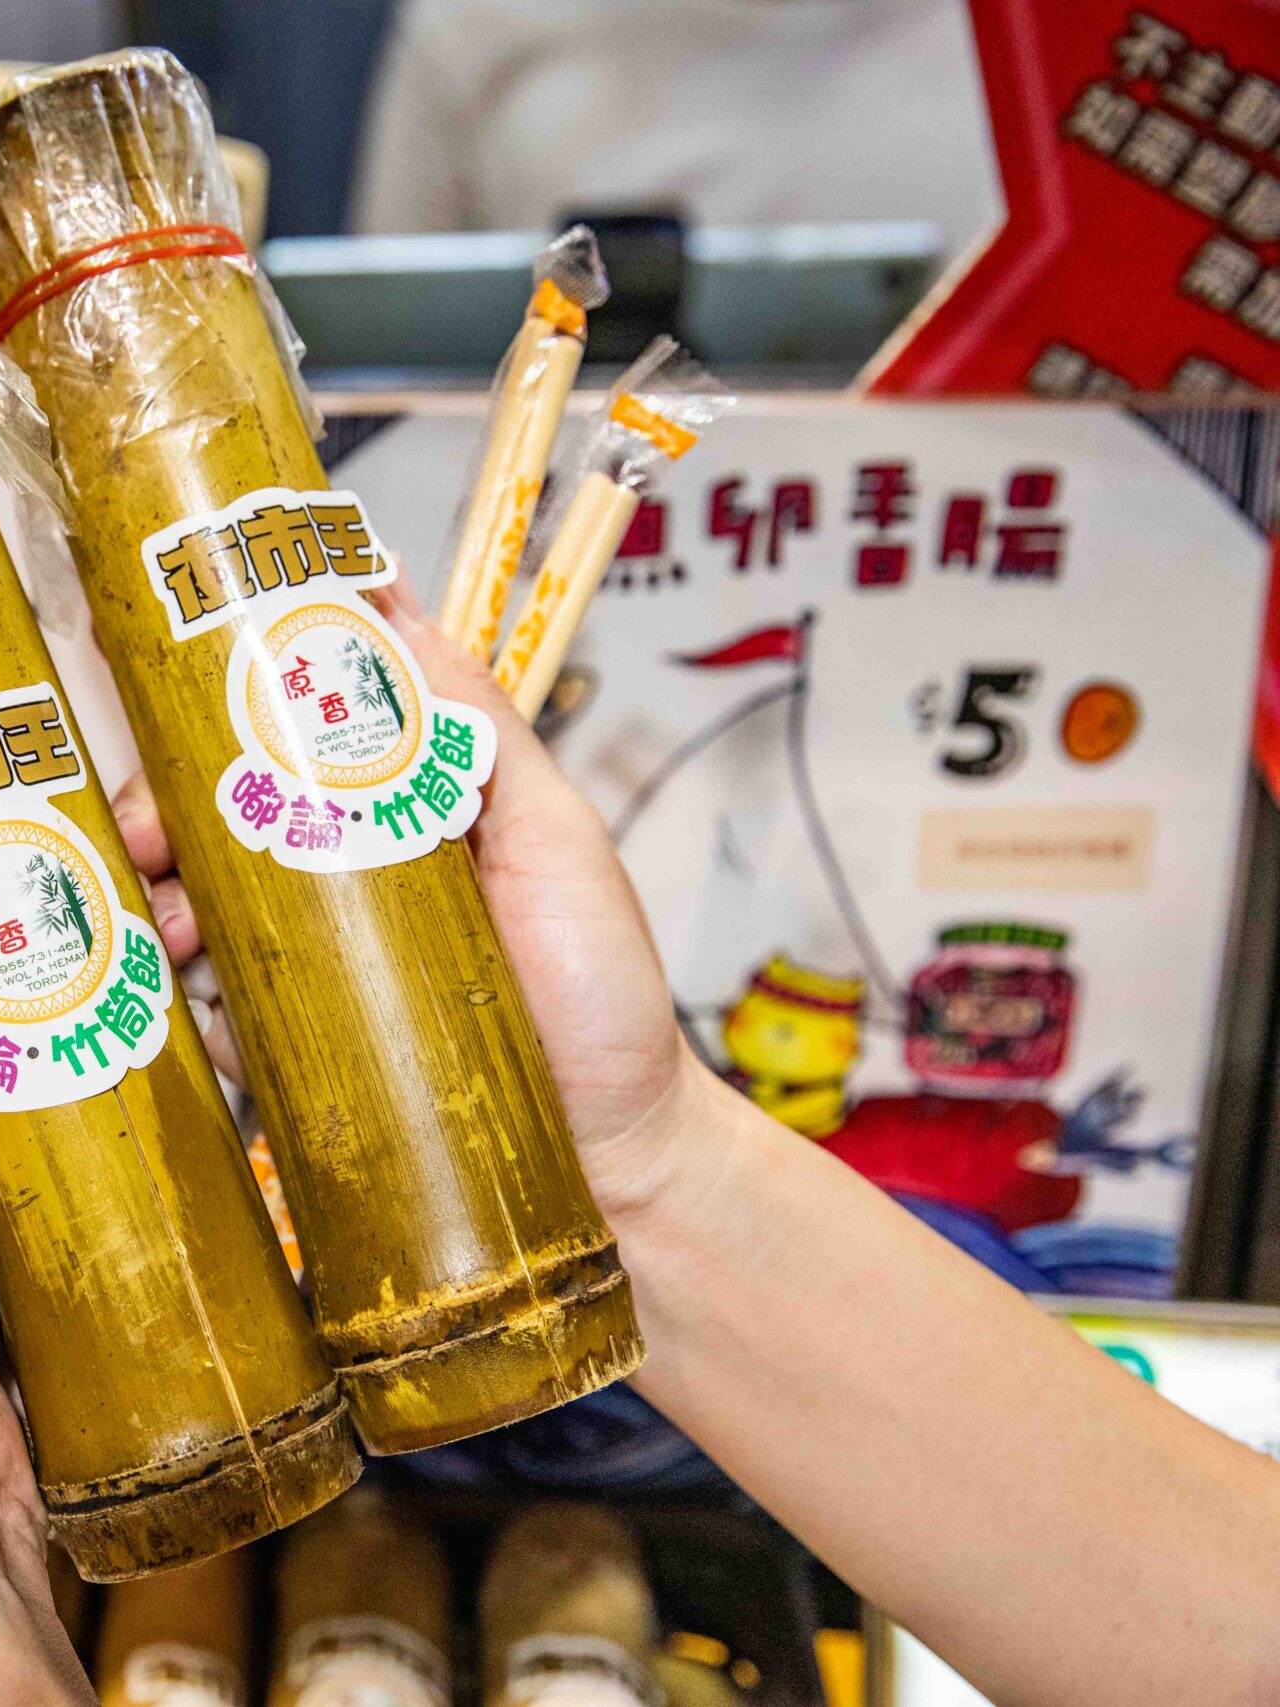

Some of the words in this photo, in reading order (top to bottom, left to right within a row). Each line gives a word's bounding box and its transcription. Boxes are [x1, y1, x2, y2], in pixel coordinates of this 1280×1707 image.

[157, 503, 386, 624] 夜市王
[315, 717, 394, 745] 0955-731-462
[328, 741, 353, 753] WOL
[348, 744, 385, 760] TORON
[4, 971, 32, 986] WOL
[36, 966, 45, 976] A
[48, 951, 86, 971] HEMAY
[25, 971, 68, 992] TORON
